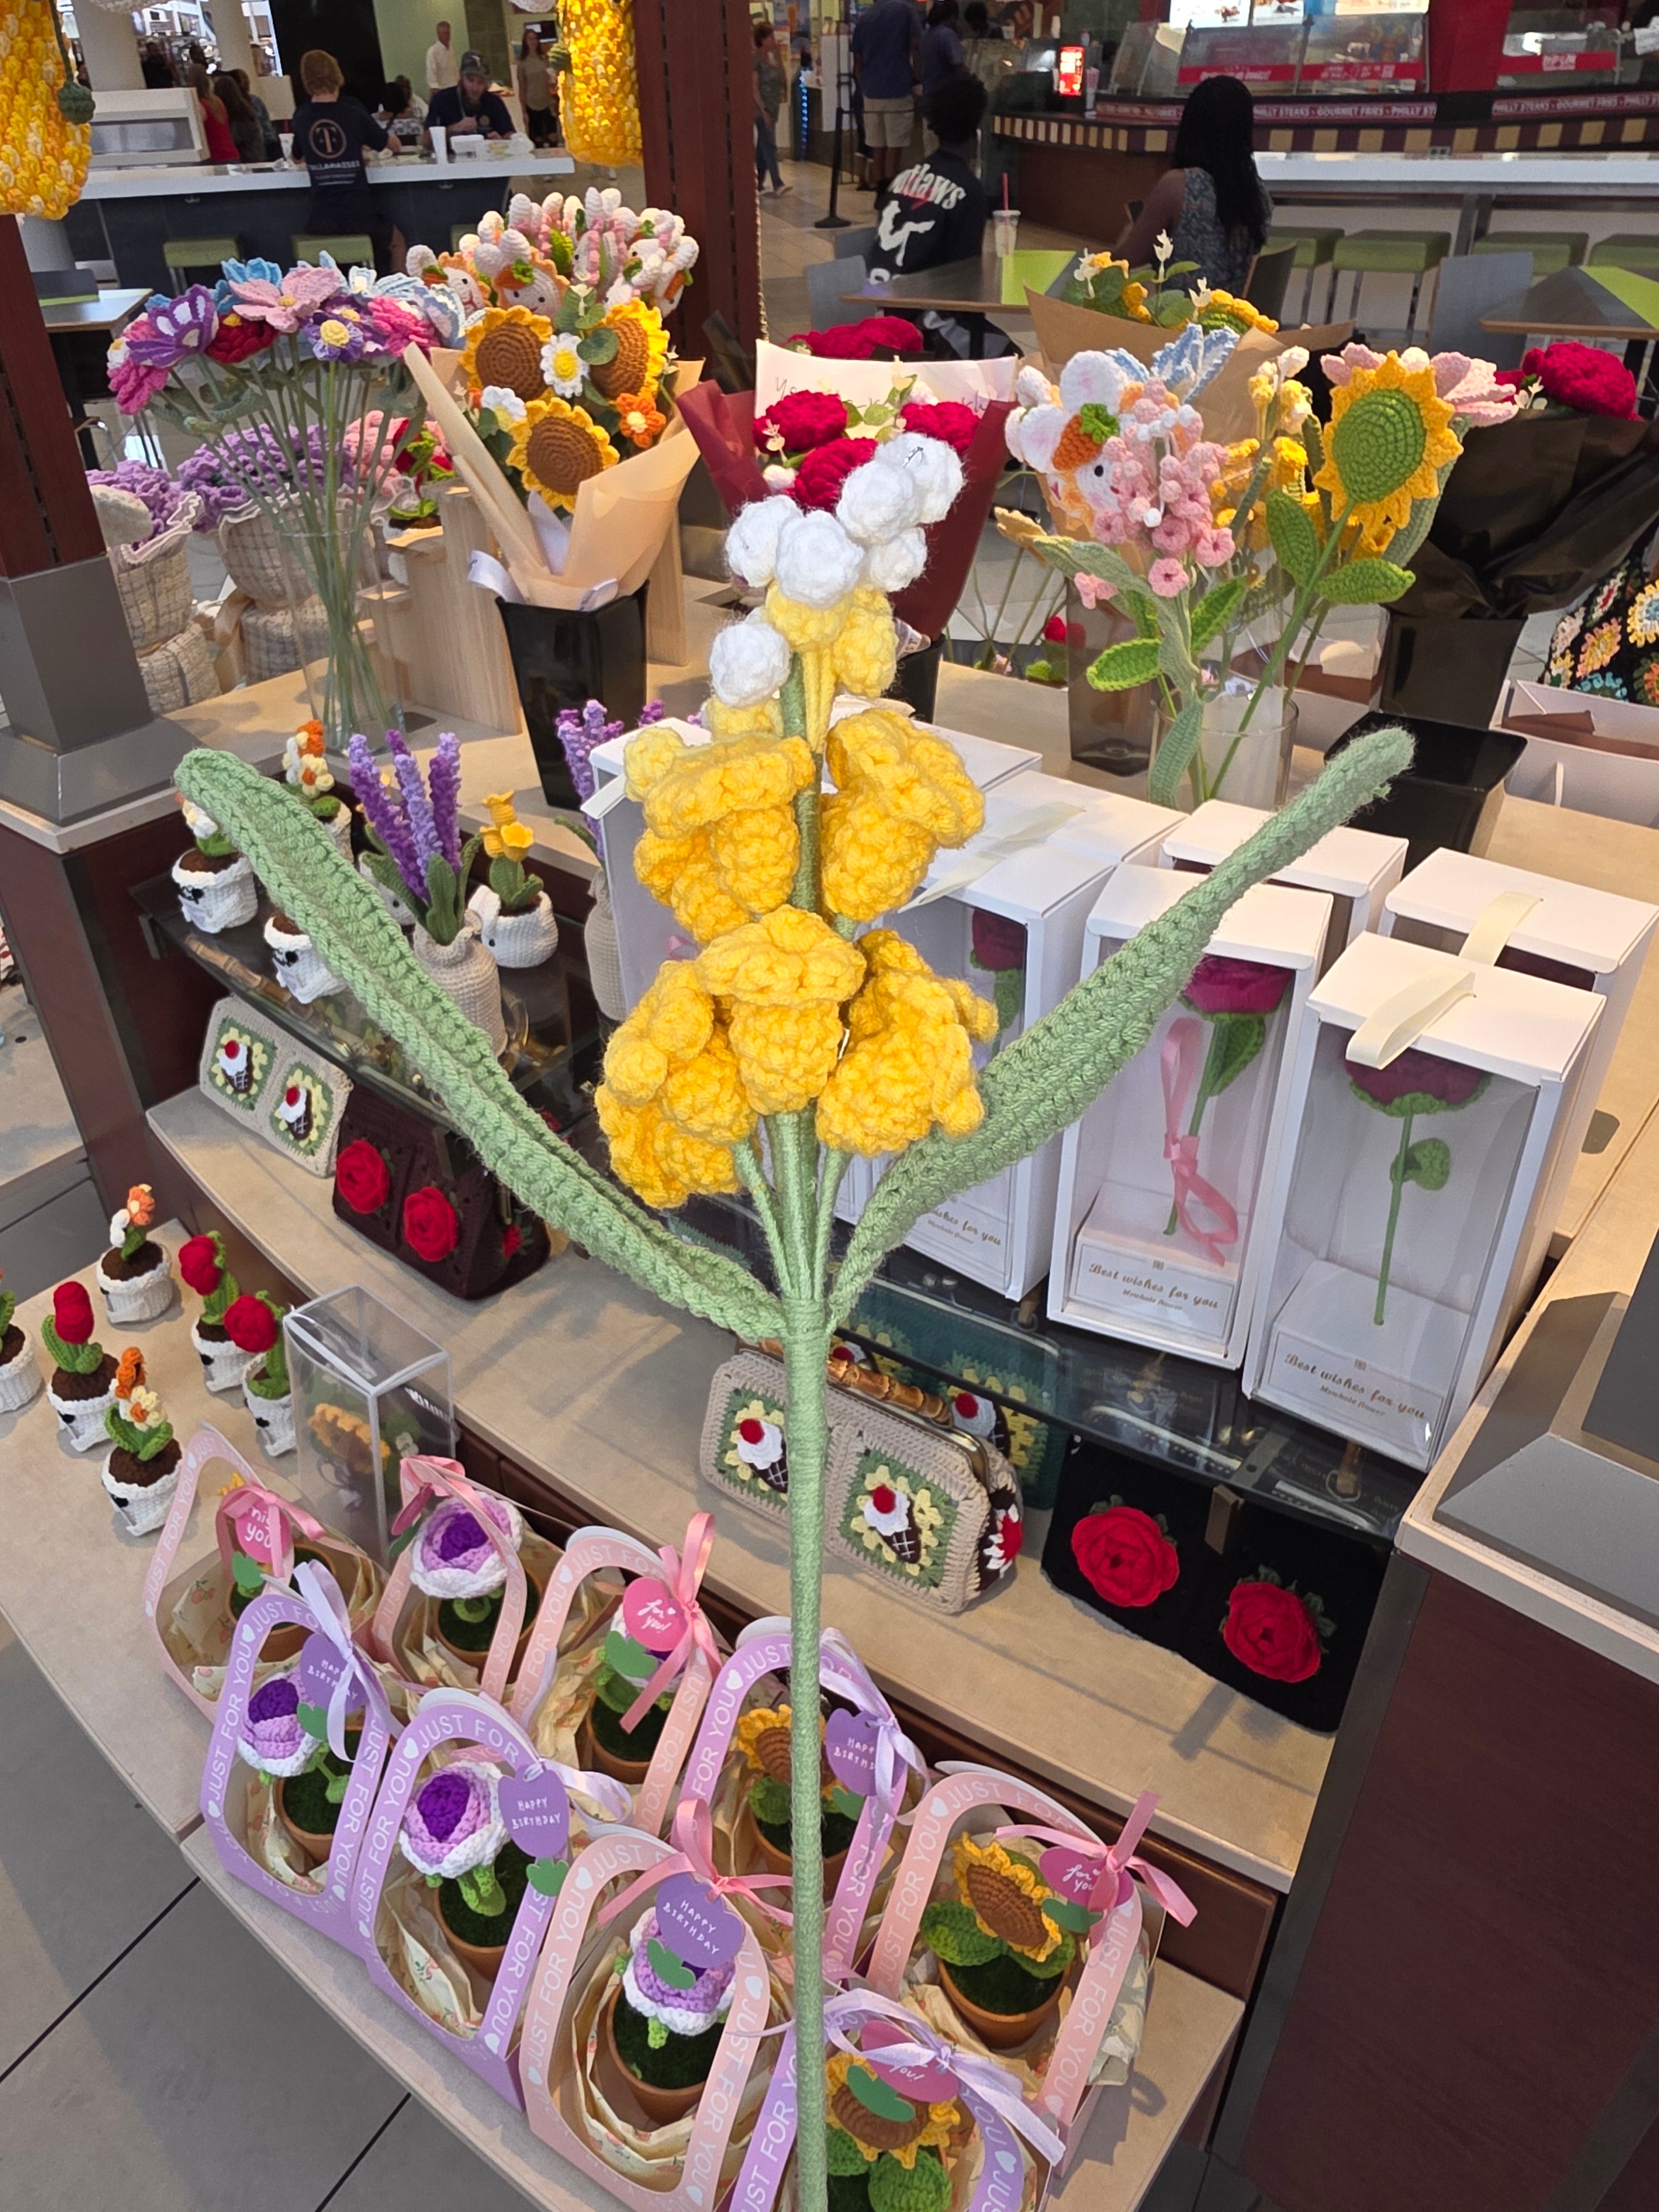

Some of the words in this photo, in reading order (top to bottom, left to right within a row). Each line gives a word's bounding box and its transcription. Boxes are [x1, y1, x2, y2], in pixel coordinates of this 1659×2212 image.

[962, 1220, 978, 1235] for
[982, 1232, 1001, 1245] you
[1089, 1262, 1119, 1280] Best
[1122, 1276, 1164, 1292] wishes
[1168, 1286, 1189, 1300] for
[1193, 1295, 1218, 1309] you
[1284, 1353, 1317, 1374] Best
[1320, 1370, 1365, 1394] wishes
[1370, 1389, 1394, 1407] for
[1397, 1402, 1426, 1420] you
[148, 1553, 166, 1600] JUST
[164, 1511, 184, 1550] FOR
[178, 1469, 194, 1505] YOU
[527, 1634, 551, 1677] FOR
[543, 1582, 568, 1625] YOU
[571, 1545, 613, 1574] JUST
[213, 1745, 229, 1801] JUST
[221, 1693, 243, 1741] FOR
[233, 1644, 252, 1686] YOU
[252, 1601, 286, 1633] JUST
[293, 1606, 319, 1629] FO
[682, 1661, 708, 1721] JUST
[691, 1746, 719, 1797] FOR
[708, 1691, 735, 1738] YOU
[743, 1642, 791, 1679] JUST
[847, 1737, 875, 1754] HAPP
[367, 1720, 385, 1778] JUST
[660, 1726, 685, 1775] FOR
[344, 1785, 370, 1834] FOR
[359, 1869, 377, 1923] JUST
[369, 1815, 394, 1865] FOR
[384, 1759, 412, 1807] YOU
[419, 1715, 463, 1749] JUST
[475, 1719, 519, 1764] FOR
[512, 1813, 561, 1829] BIRTHDAY
[517, 1797, 548, 1812] HAPPY
[639, 1781, 666, 1829] YOU
[333, 1843, 354, 1887] YOU
[592, 1845, 641, 1879] JUST
[846, 1844, 877, 1897] FOR
[879, 1924, 905, 1982] JUST
[895, 1871, 925, 1922] FOR
[914, 1816, 942, 1864] YOU
[945, 1780, 1000, 1811] JUST
[555, 1890, 582, 1944] YOU
[663, 1902, 719, 1955] BIRTHDAY
[680, 1900, 717, 1933] HAPPY
[832, 1906, 858, 1953] YOU
[508, 1929, 538, 1979] FOR
[1101, 1913, 1129, 1979] JUST
[540, 1952, 567, 2005] FOR
[492, 1986, 518, 2036] YOU
[726, 1999, 758, 2070] JUST
[1073, 1983, 1107, 2036] FOR
[532, 2011, 554, 2069] JUST
[1052, 2044, 1089, 2094] YOU
[705, 2073, 735, 2133] FOR
[962, 2088, 1008, 2146] YOU
[741, 2164, 771, 2212] UST
[760, 2100, 795, 2162] FOR
[781, 2054, 797, 2089] YO
[691, 2140, 717, 2189] YOU
